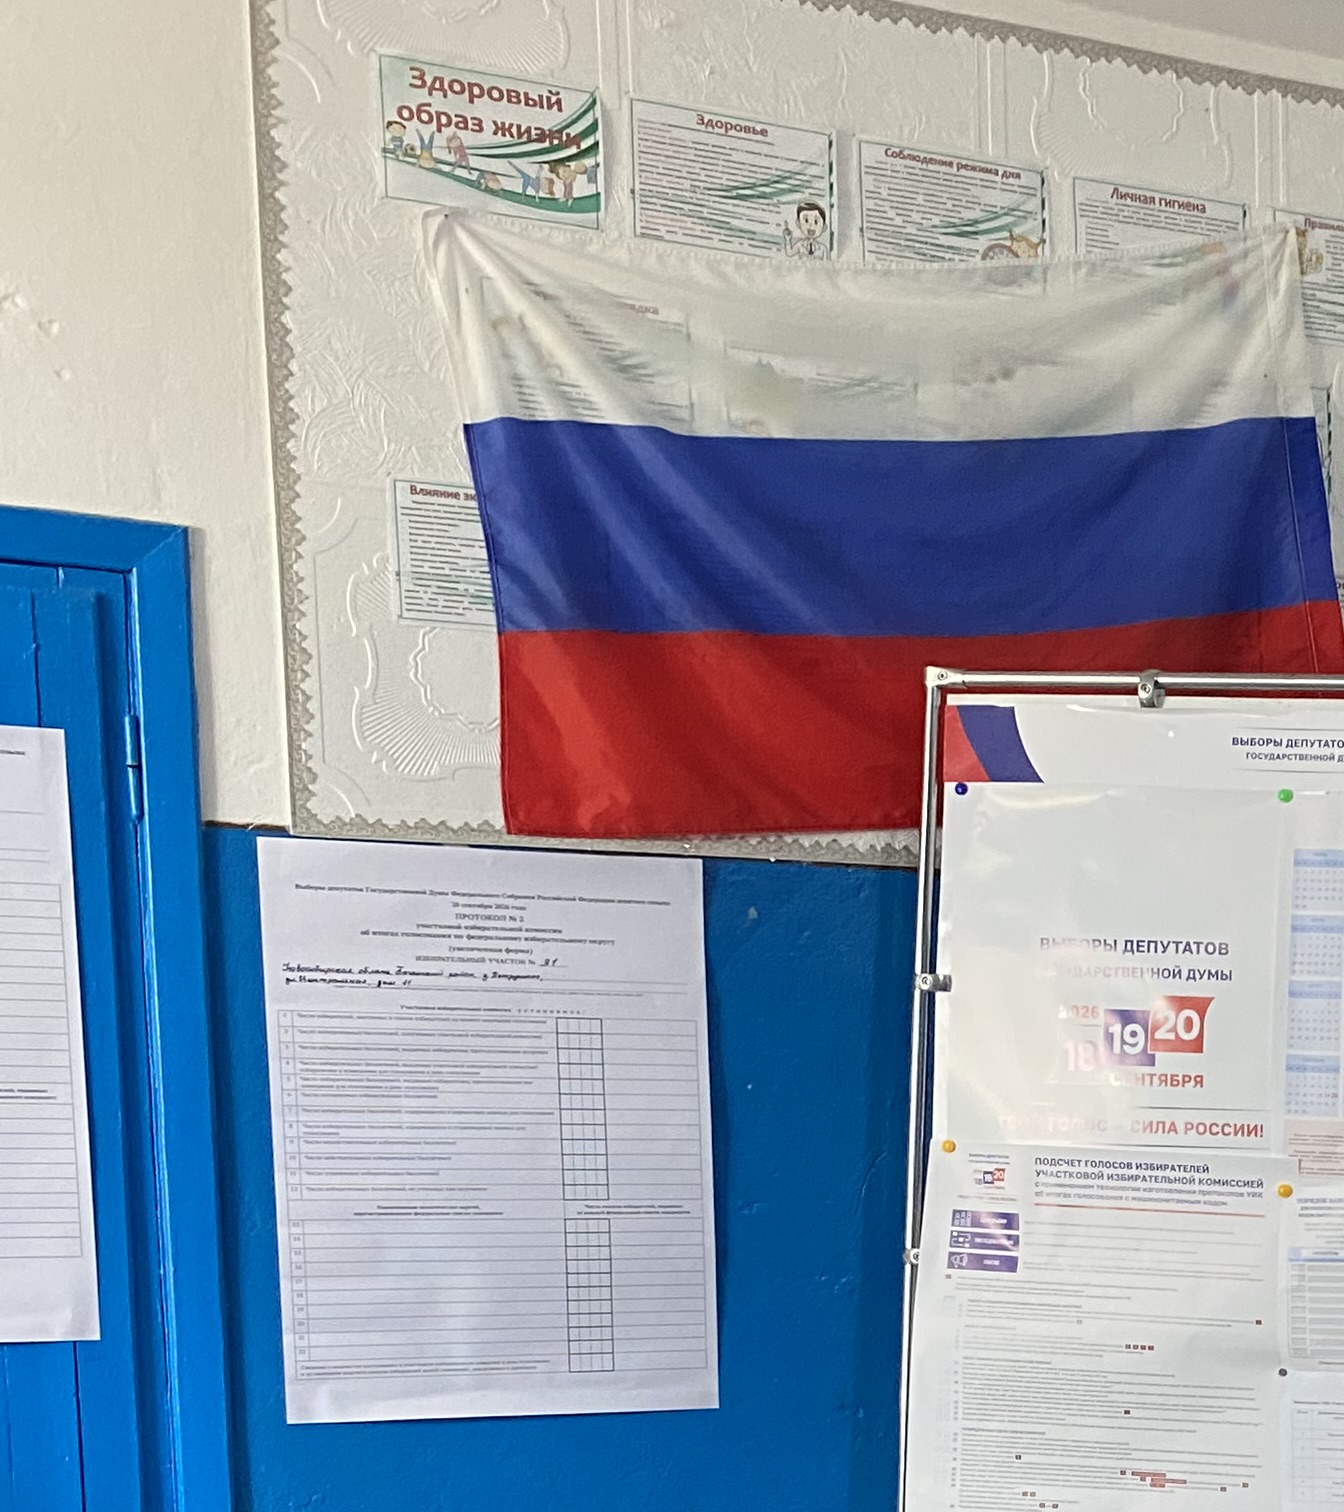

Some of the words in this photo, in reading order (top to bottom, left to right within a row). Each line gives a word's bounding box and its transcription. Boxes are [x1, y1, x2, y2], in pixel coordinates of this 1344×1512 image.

[409, 66, 563, 113] Здоровый
[396, 102, 484, 133] образ
[491, 119, 582, 150] жизни
[696, 113, 769, 137] Здоровье
[885, 147, 954, 169] Соблюдение
[956, 162, 999, 177] режима
[1001, 170, 1021, 180] дня
[1110, 187, 1155, 208] Личная
[1158, 196, 1206, 214] гигиена
[409, 485, 461, 500] Влияние
[1231, 736, 1283, 749] ВЫБОРЫ
[1246, 752, 1335, 763] ГОСУДАРСТВЕННОЙ
[1122, 939, 1230, 956] ДЕПУТАТОВ
[1186, 967, 1233, 982] ДУМЫ
[1154, 1009, 1200, 1041] 20
[1108, 1023, 1146, 1056] 19
[1109, 1073, 1204, 1089] СНТЯБРЯ
[1130, 1121, 1179, 1136] СИЛА
[1184, 1121, 1264, 1138] РОССИИ!
[1034, 1157, 1082, 1168] ПОДСЧЕТ
[1084, 1159, 1133, 1171] ГОЛОСОВ
[1135, 1161, 1209, 1173] ИЗБИРАТЕЛЕЙ
[1034, 1169, 1105, 1182] УЧАСТКОВОЙ
[1106, 1172, 1197, 1186] ИЗБИРАТЕЛЬНОЙ
[1198, 1176, 1264, 1189] КОМИССИЕЙ
